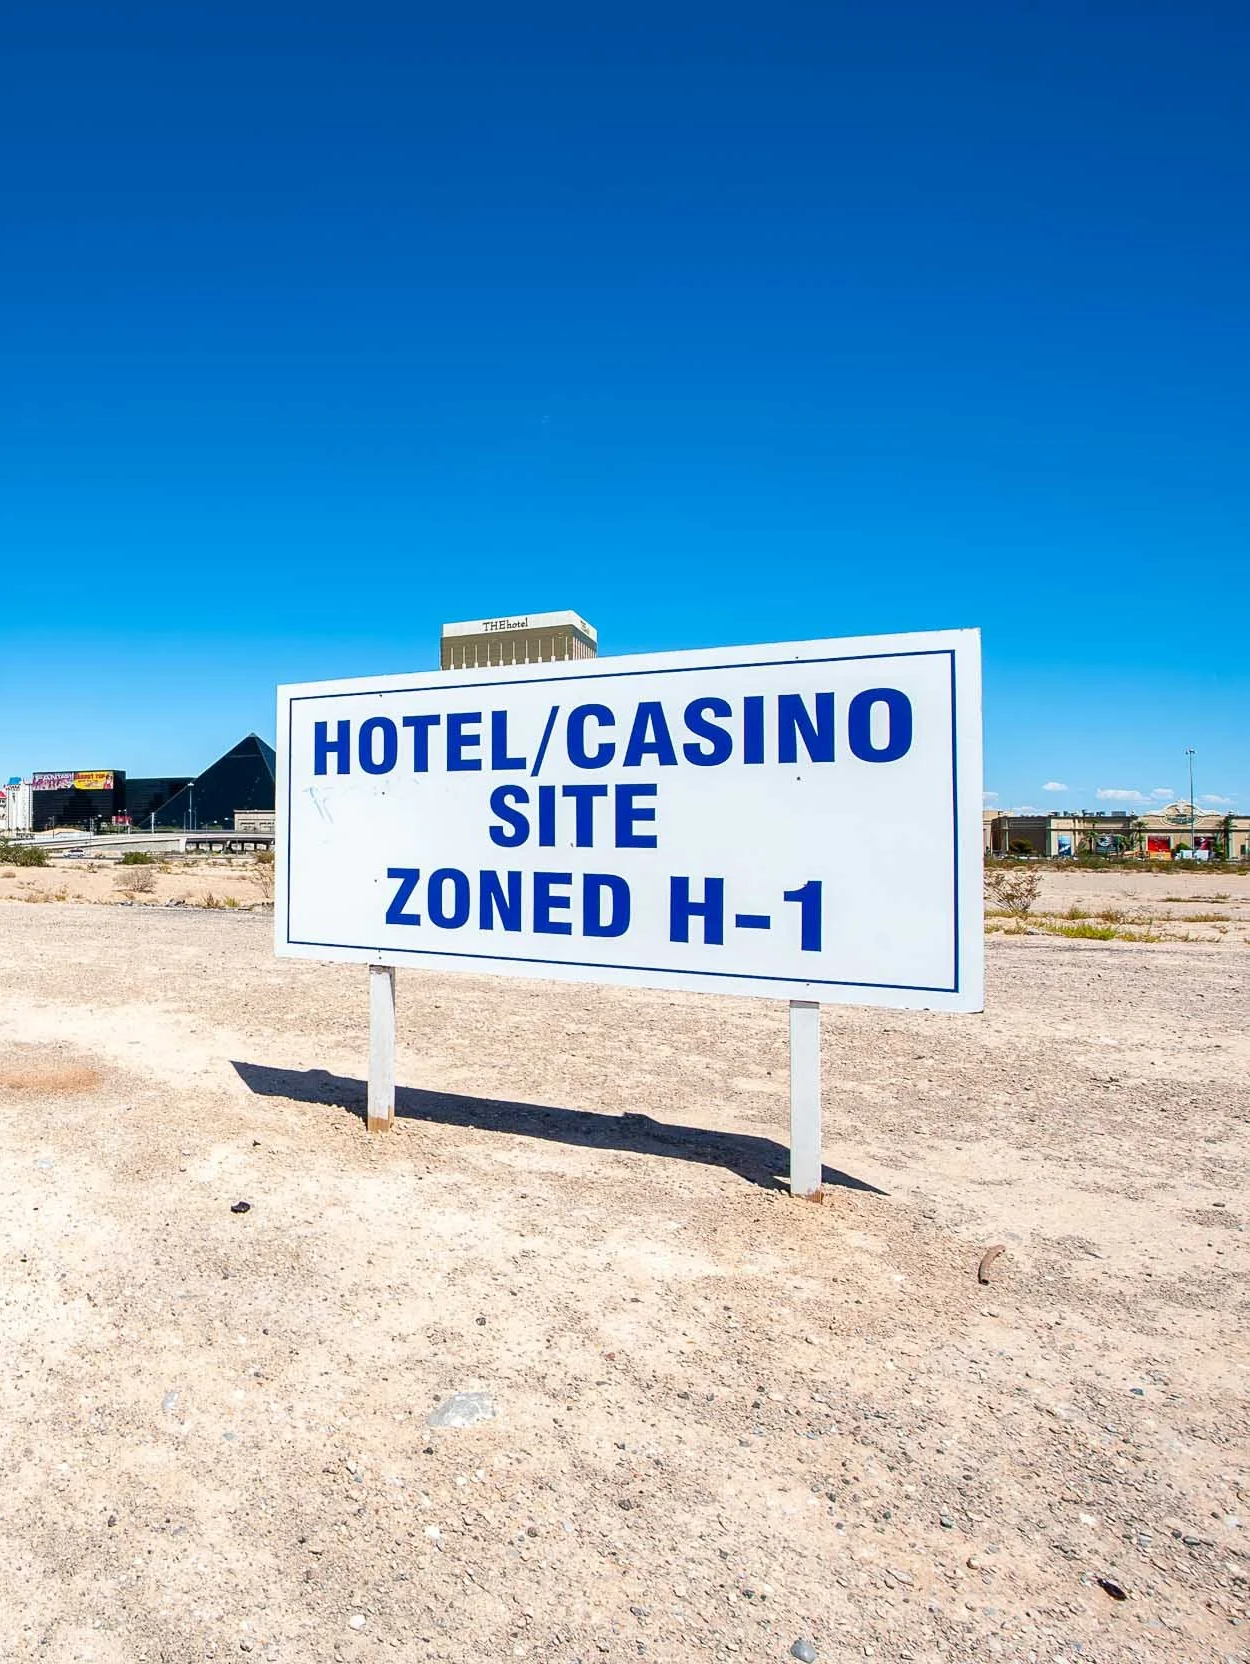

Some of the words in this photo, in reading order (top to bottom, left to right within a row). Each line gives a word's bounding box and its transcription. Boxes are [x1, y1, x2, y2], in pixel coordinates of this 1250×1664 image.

[483, 617, 528, 631] THEhotel
[315, 688, 912, 776] HOTEL/CASINO
[489, 784, 658, 849] SITE
[386, 868, 631, 938] ZONED
[670, 876, 823, 953] H-1
